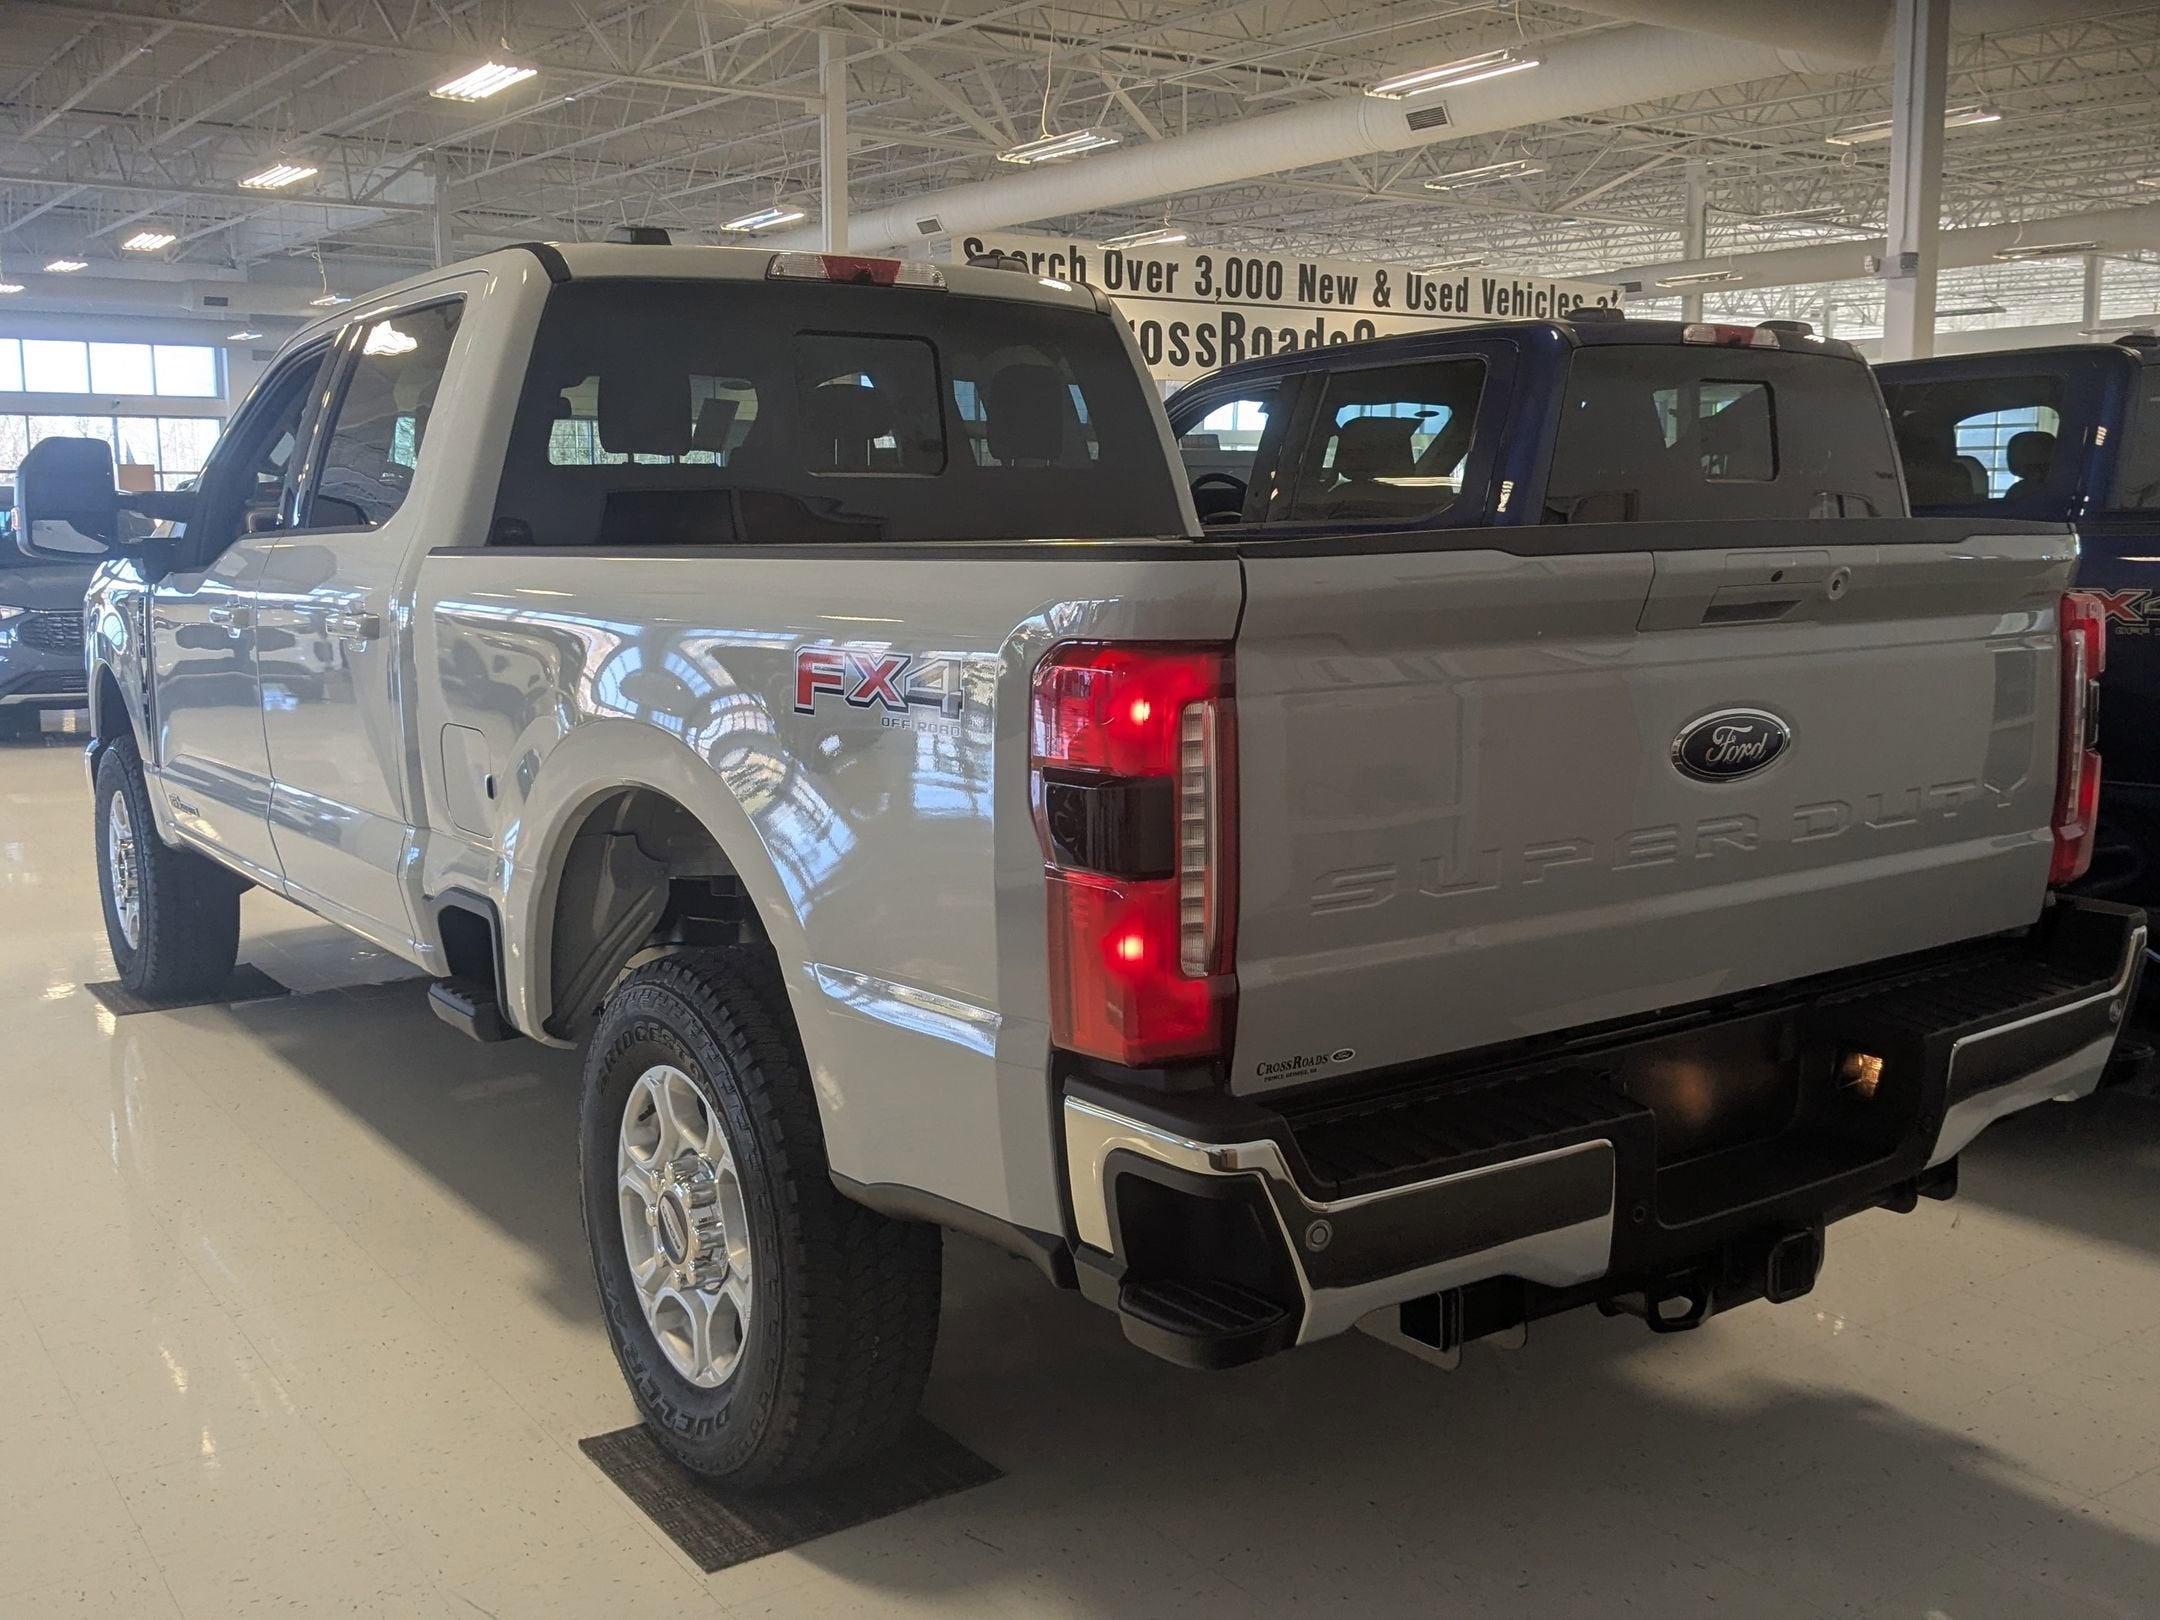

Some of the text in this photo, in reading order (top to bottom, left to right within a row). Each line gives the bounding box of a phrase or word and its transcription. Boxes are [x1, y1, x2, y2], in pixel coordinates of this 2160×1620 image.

[963, 236, 1087, 282] Srch
[1104, 249, 1179, 293] Over
[1194, 254, 1284, 304] 3,000
[1298, 263, 1359, 305] New
[1372, 269, 1391, 308] &
[1406, 271, 1469, 313] Used
[793, 645, 964, 720] FX4
[881, 716, 961, 738] OFF ROAD
[1704, 725, 1769, 765] Ford
[1310, 776, 2028, 916] SUPER DUTY
